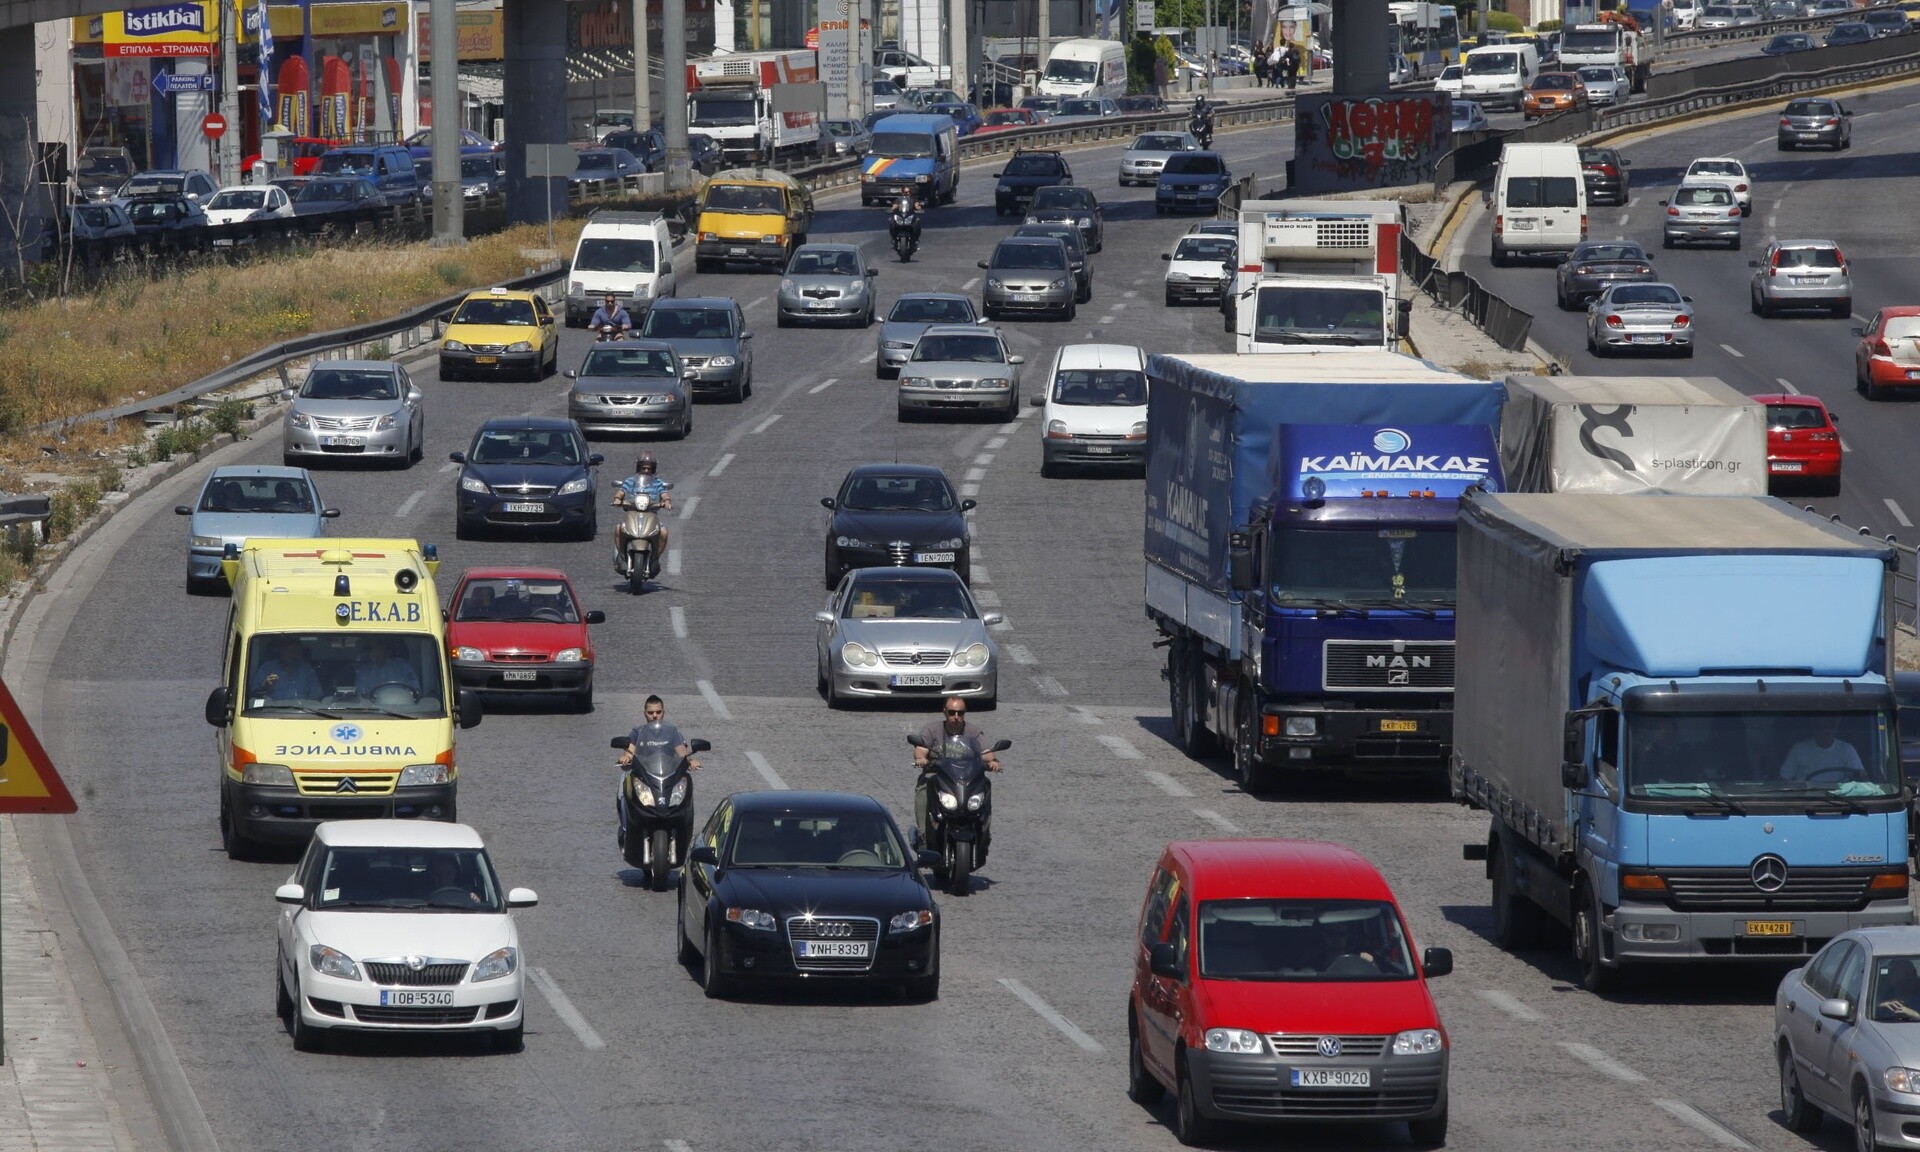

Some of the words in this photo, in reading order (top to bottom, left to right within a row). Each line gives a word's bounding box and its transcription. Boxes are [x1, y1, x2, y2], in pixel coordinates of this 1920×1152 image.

[127, 8, 201, 31] istikbal
[162, 45, 209, 54] ΣΤΡΩΜΑΤΑ
[203, 76, 212, 88] P
[1652, 457, 1741, 473] s-plasticon.gr
[1366, 655, 1431, 668] MAN
